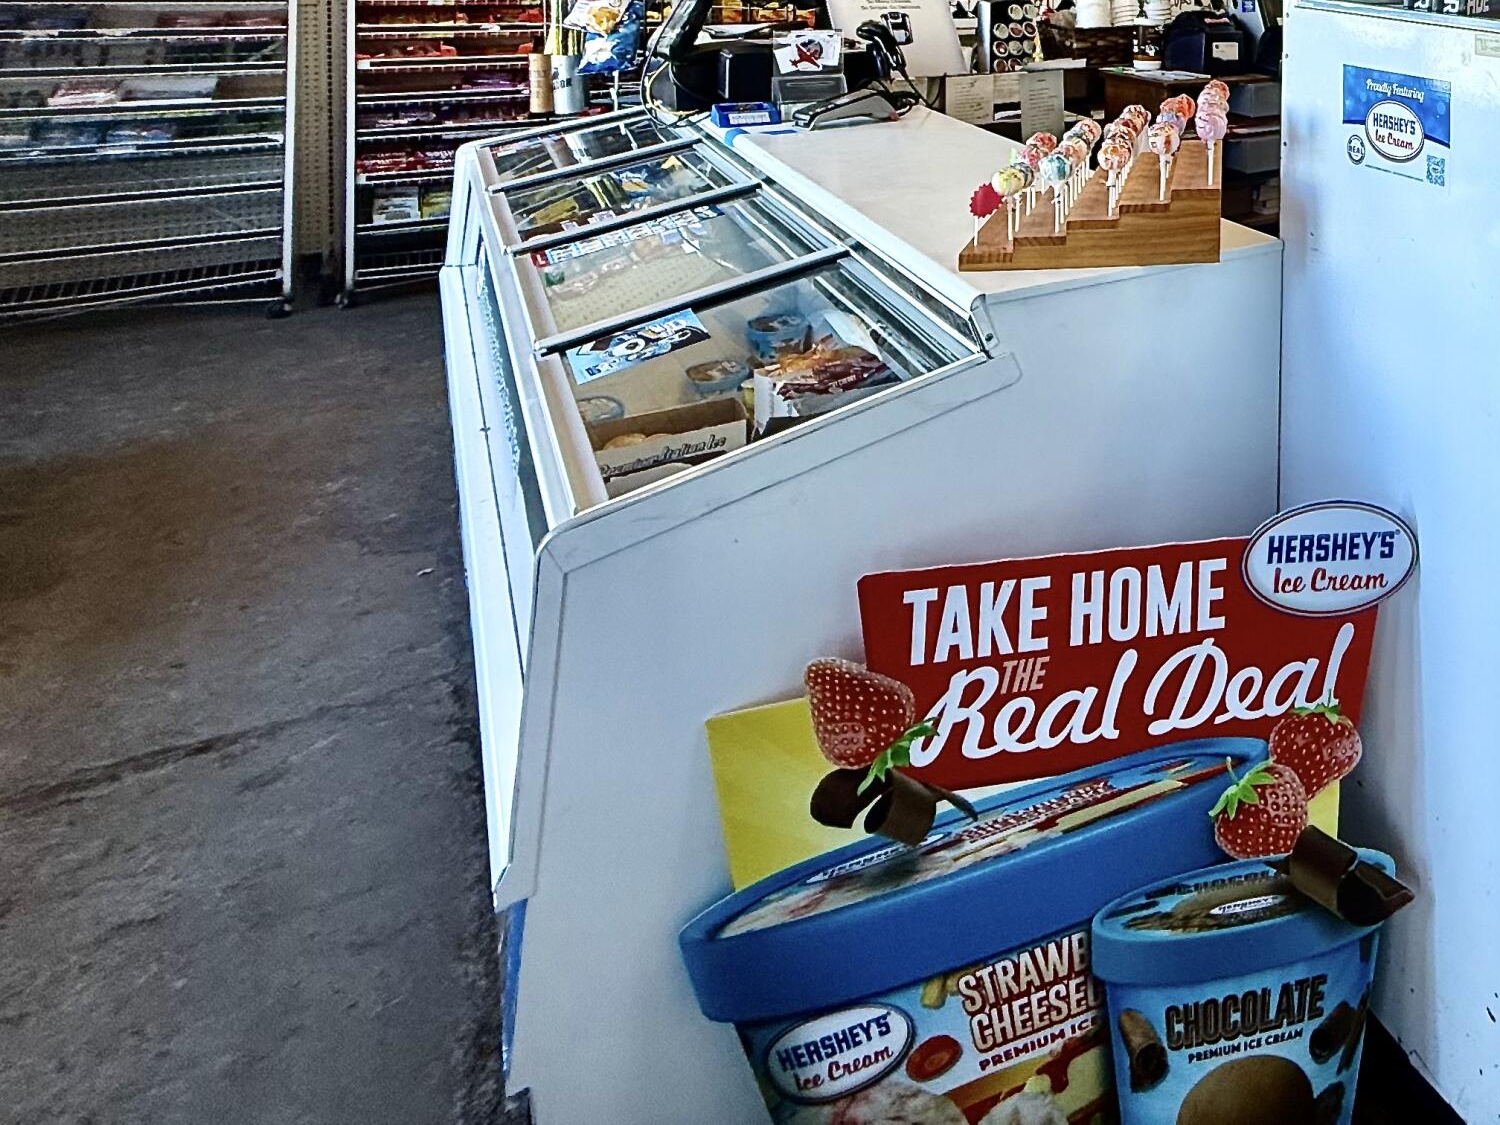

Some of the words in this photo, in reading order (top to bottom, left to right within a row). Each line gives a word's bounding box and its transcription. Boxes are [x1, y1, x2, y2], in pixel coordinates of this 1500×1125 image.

[1366, 78, 1392, 98] Proudly
[1392, 83, 1425, 103] Featuring
[1373, 112, 1416, 135] HERSHEY'S
[1375, 129, 1386, 144] Ice
[1387, 135, 1415, 150] Cream
[708, 434, 727, 452] Ice
[1267, 530, 1394, 564] HERSHEY'S
[1273, 568, 1305, 593] Ice
[1310, 567, 1388, 592] Cream
[903, 576, 1050, 665] TAKE
[1070, 558, 1227, 646] HOME
[1001, 657, 1050, 694] THE
[909, 648, 1139, 767] Real
[1144, 623, 1355, 735] Deal
[1165, 973, 1328, 1051] CHOCOLATE
[776, 1014, 891, 1073] HERSHEY'S
[979, 1028, 1066, 1072] PREMIUM
[1188, 1042, 1241, 1064] PREMIUM
[1243, 1036, 1262, 1051] ICE
[1264, 1028, 1303, 1046] CREAM
[793, 1069, 825, 1091] Ice
[828, 1045, 894, 1081] Cream
